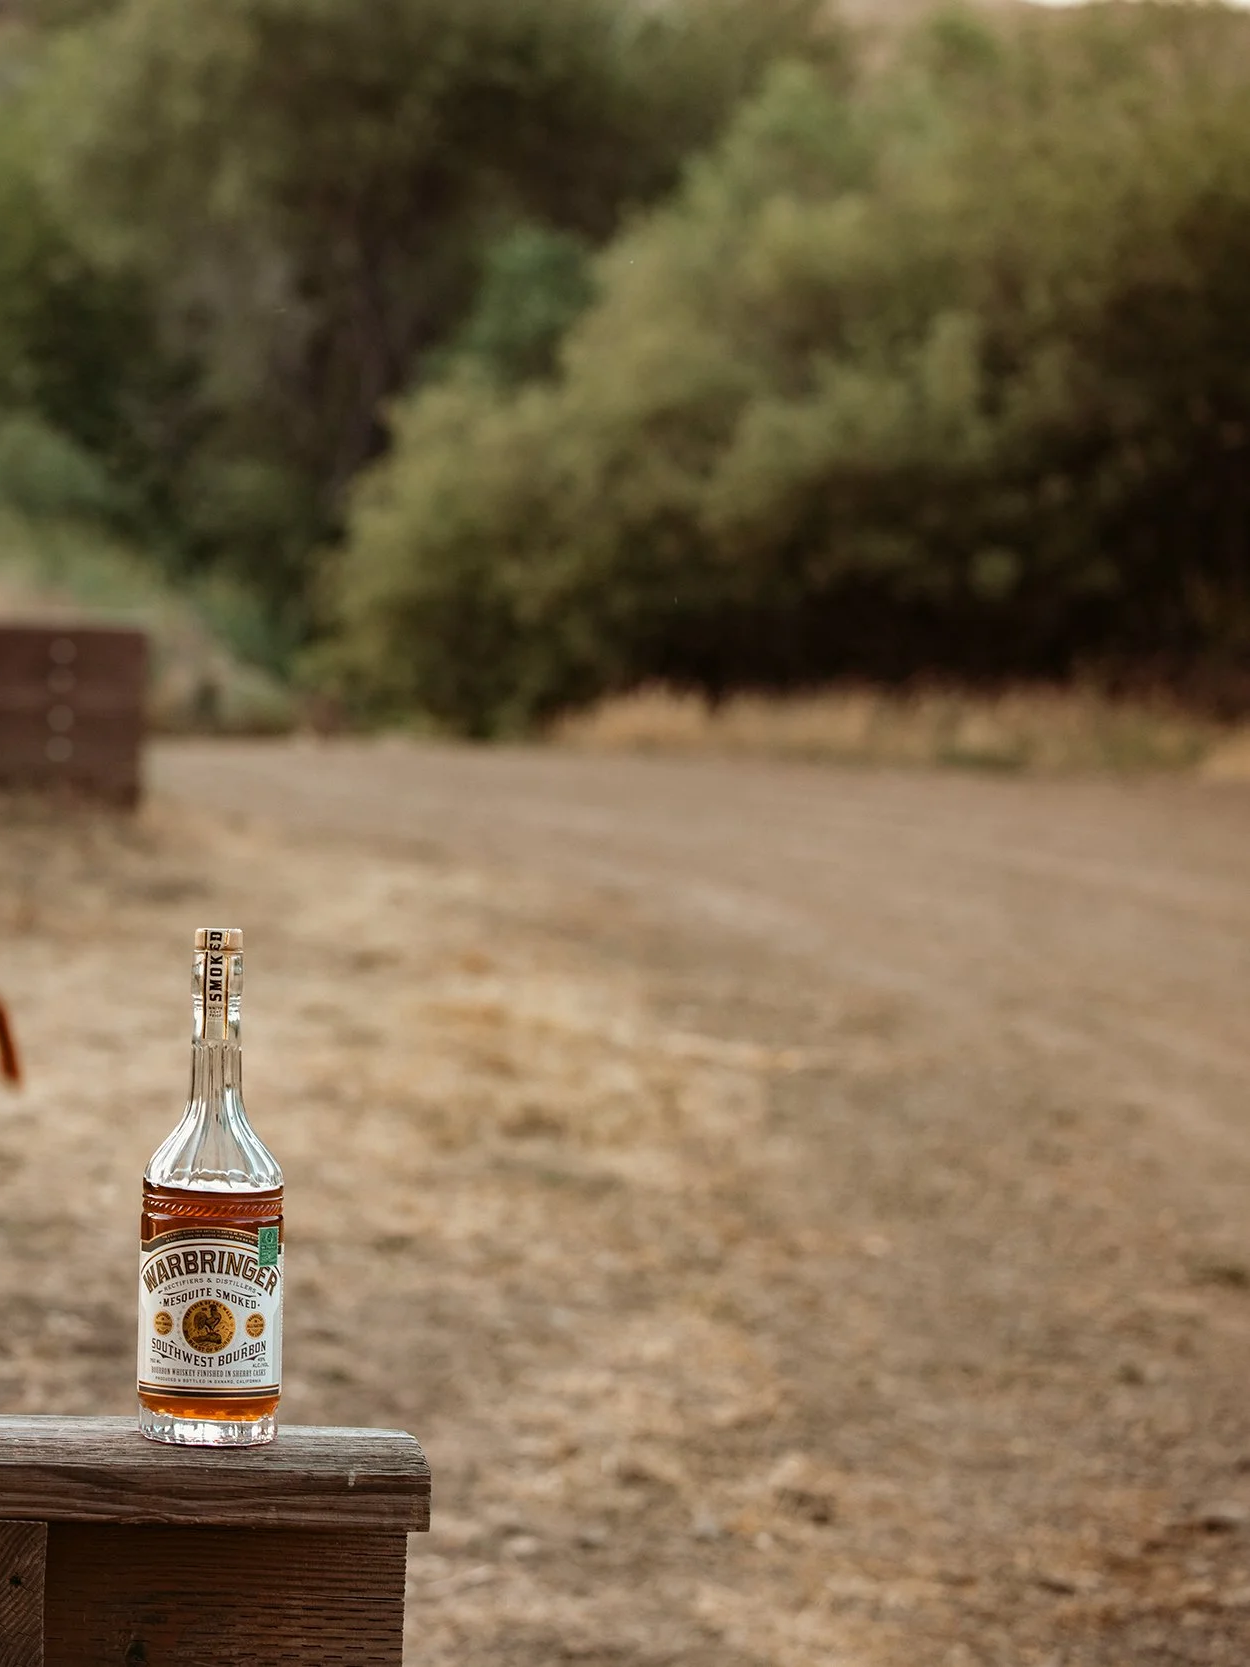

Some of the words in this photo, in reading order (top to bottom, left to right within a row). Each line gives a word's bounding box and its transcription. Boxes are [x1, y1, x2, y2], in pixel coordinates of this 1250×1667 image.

[210, 932, 223, 1001] SMOKED
[143, 1250, 278, 1296] WARBRINGER
[164, 1278, 204, 1292] RECTIFIERS
[216, 1278, 256, 1293] DISTILLERS
[163, 1288, 212, 1307] MESQUITE
[216, 1289, 256, 1309] SMOKED
[152, 1338, 213, 1368] SOUTHWEST
[219, 1340, 267, 1367] BOURBON
[151, 1366, 170, 1375] BOURBON
[172, 1367, 195, 1377] WHISKEY
[197, 1369, 224, 1378] FINISHED
[225, 1369, 231, 1378] IN
[232, 1369, 252, 1378] SHERRY
[253, 1368, 266, 1376] CASKS
